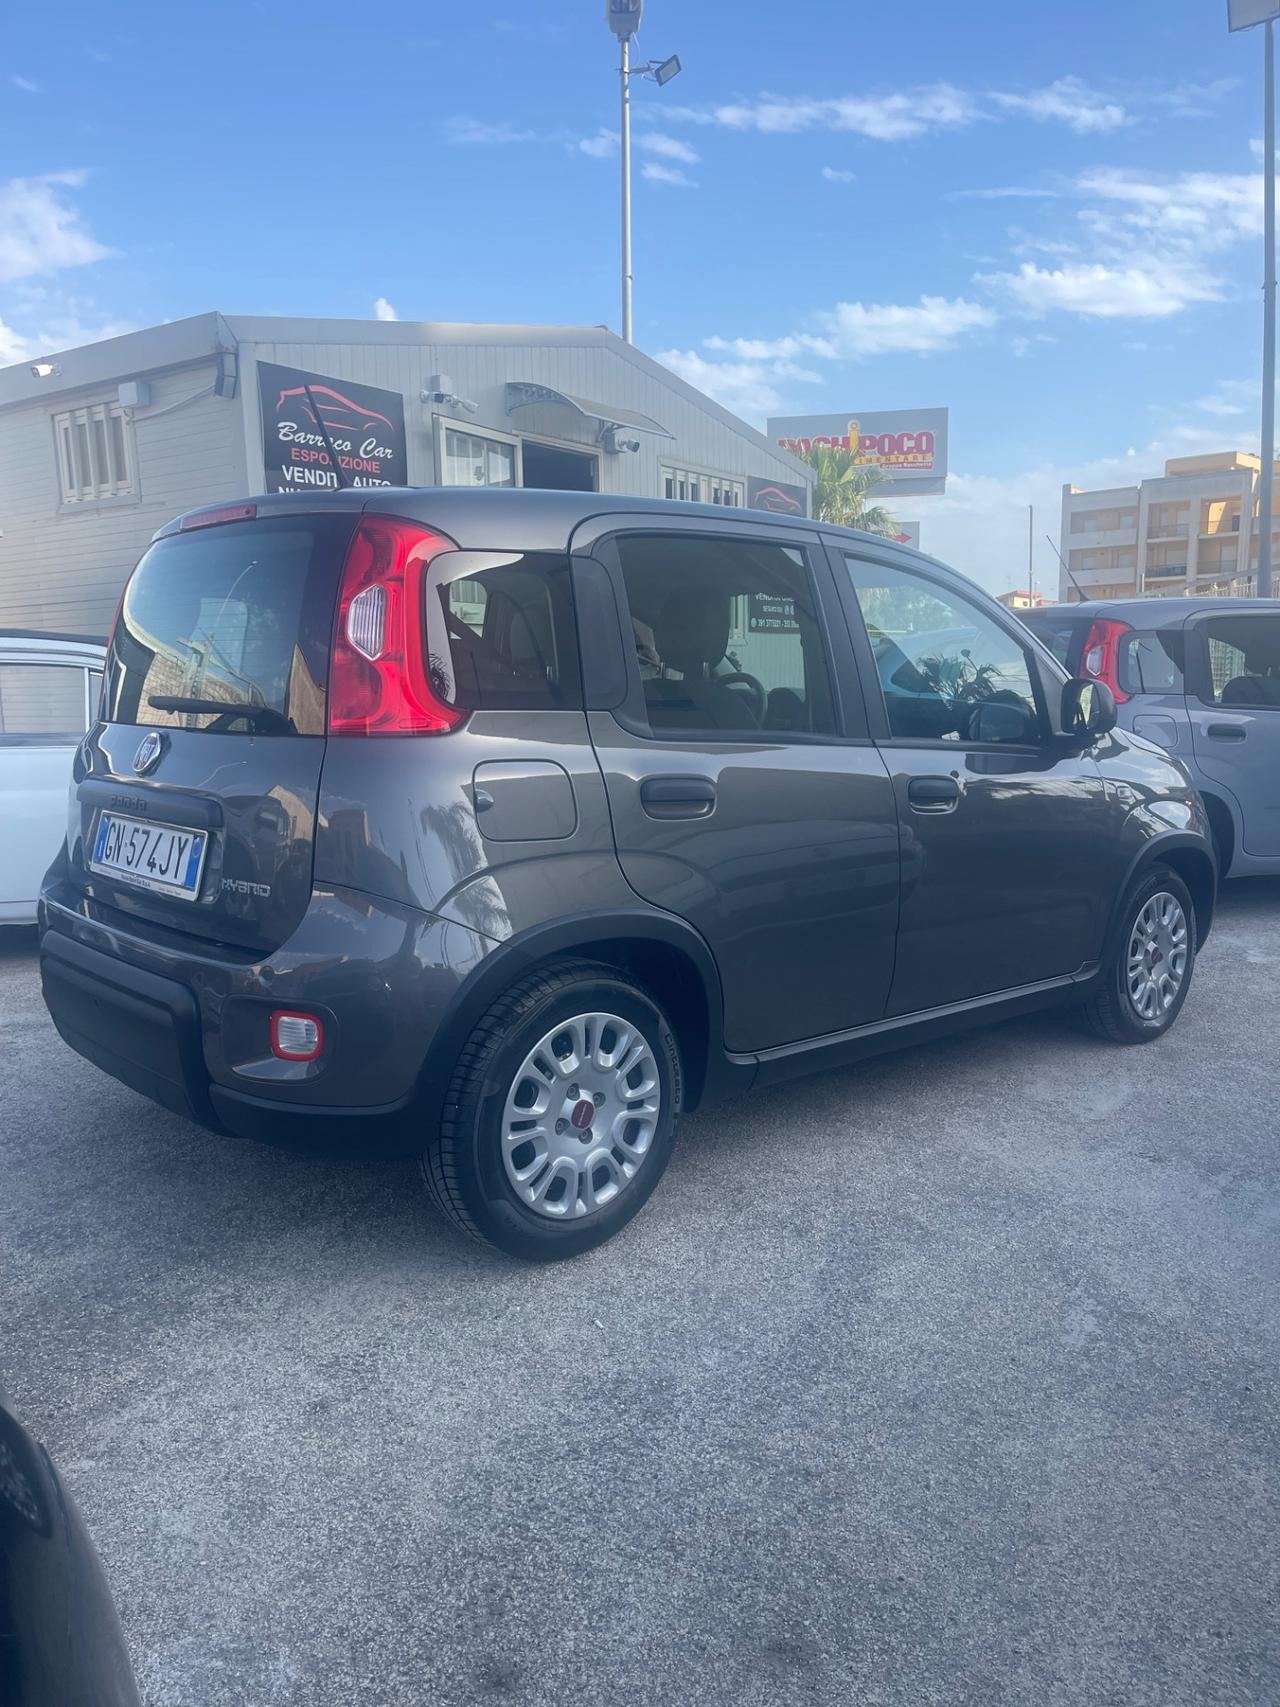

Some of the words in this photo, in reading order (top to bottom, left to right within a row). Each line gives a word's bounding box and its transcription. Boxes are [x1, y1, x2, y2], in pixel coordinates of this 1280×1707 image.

[277, 421, 352, 451] Barrco
[359, 438, 394, 459] Car
[291, 447, 381, 473] ESPOIZIONE
[281, 464, 339, 488] VENDIT
[221, 878, 271, 898] HYBRID
